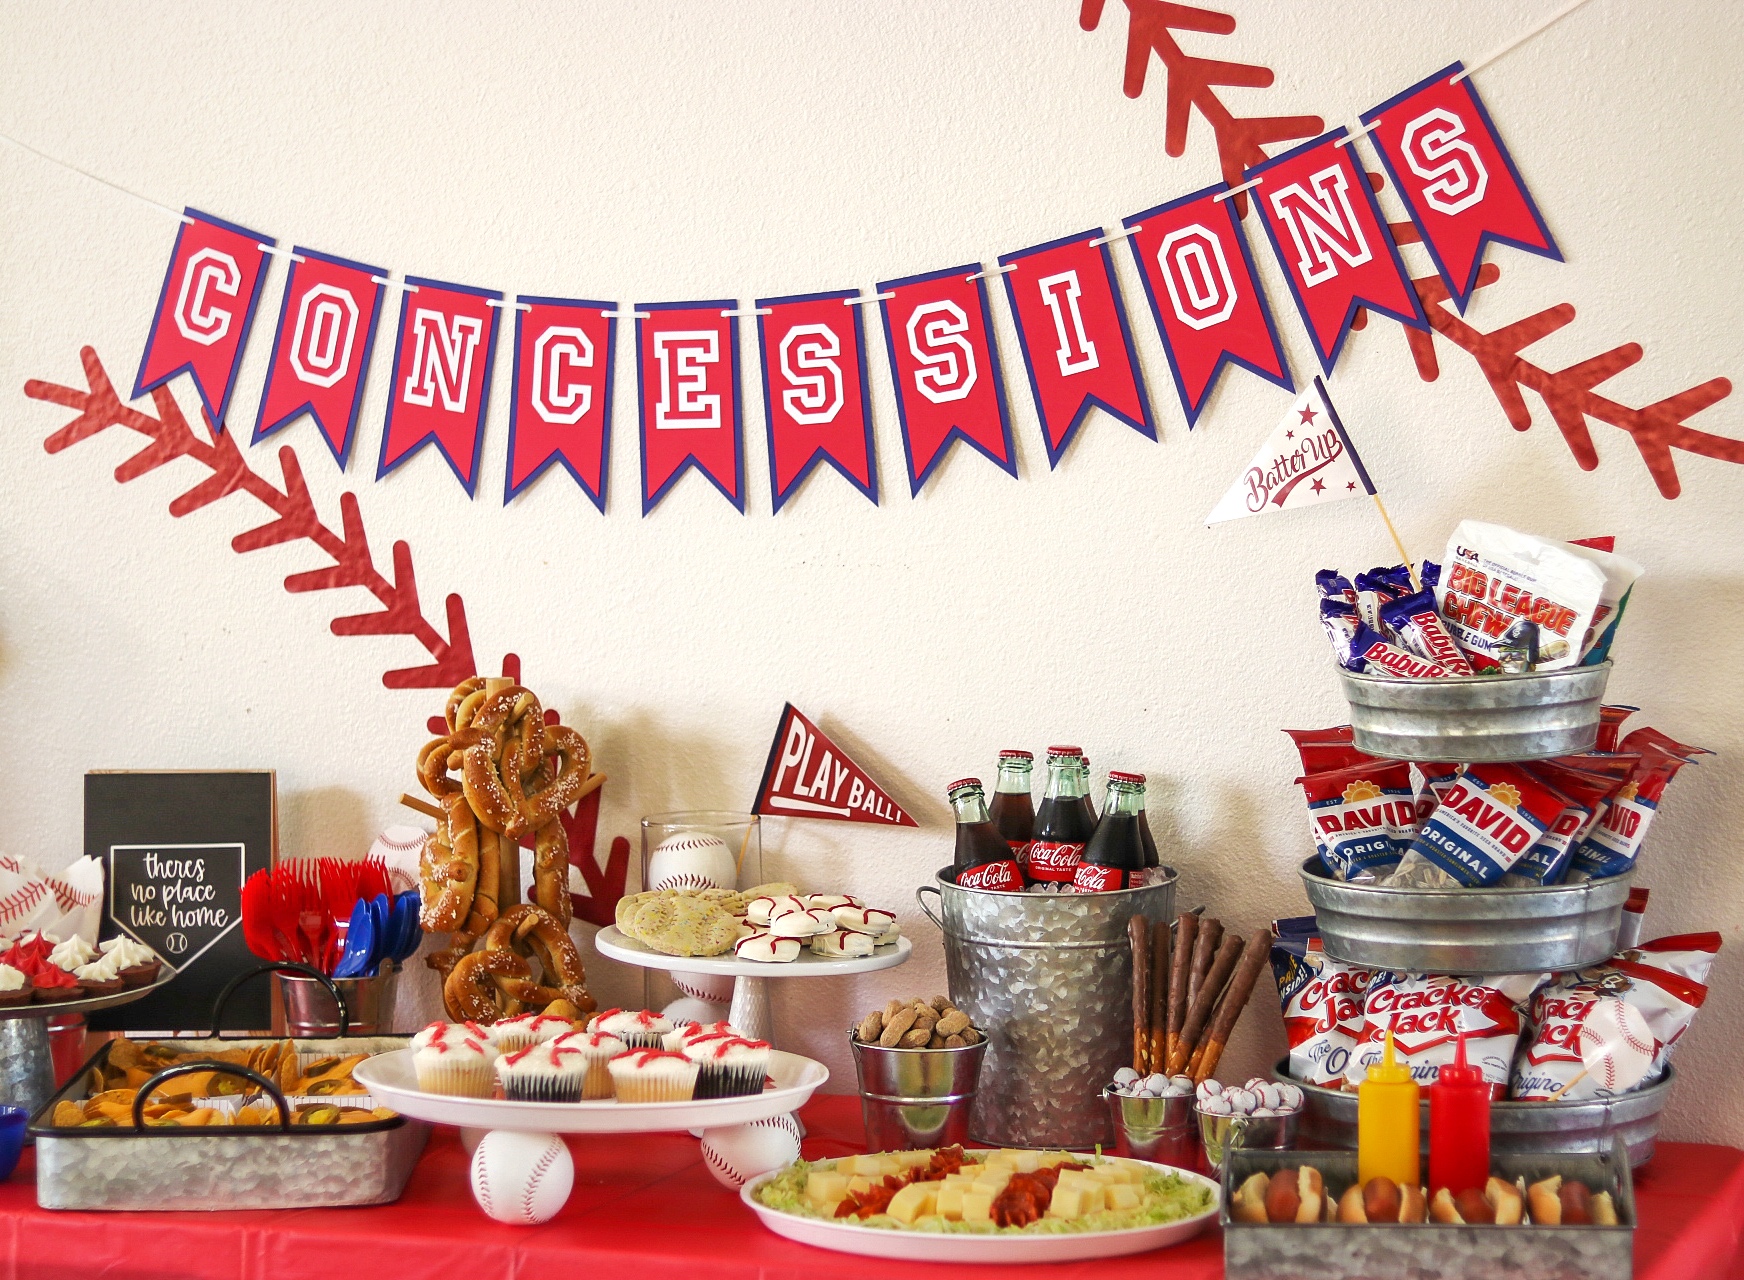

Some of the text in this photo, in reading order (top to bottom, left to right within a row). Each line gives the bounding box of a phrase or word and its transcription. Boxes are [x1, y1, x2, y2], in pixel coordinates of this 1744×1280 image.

[173, 106, 1490, 430] CONCESSIONS
[1243, 449, 1306, 512] Batter
[1442, 590, 1515, 640] CHEW
[1446, 560, 1489, 601] BIG
[1487, 577, 1579, 639] LEAGUE
[1363, 641, 1450, 678] BabyR
[1411, 611, 1472, 677] BabyR
[1470, 635, 1493, 652] GUM
[771, 714, 902, 823] PLAY BALL!
[1316, 800, 1417, 836] DAVID
[1441, 783, 1531, 854] DAVID
[1601, 802, 1642, 839] AVID
[142, 852, 206, 882] theres
[1030, 840, 1087, 867] Coca-Cola
[1420, 826, 1490, 880] ORIGINAL
[1579, 845, 1612, 864] GINAL
[960, 861, 1012, 888] Coca-Cola
[131, 879, 216, 910] no place
[130, 904, 229, 928] like home
[1279, 964, 1308, 1003] NSIDE!
[1300, 971, 1369, 1011] Crac
[1366, 982, 1496, 1015] Cracker
[1371, 1005, 1462, 1044] Jack
[1531, 993, 1599, 1027] Crack
[1537, 1023, 1583, 1057] ack
